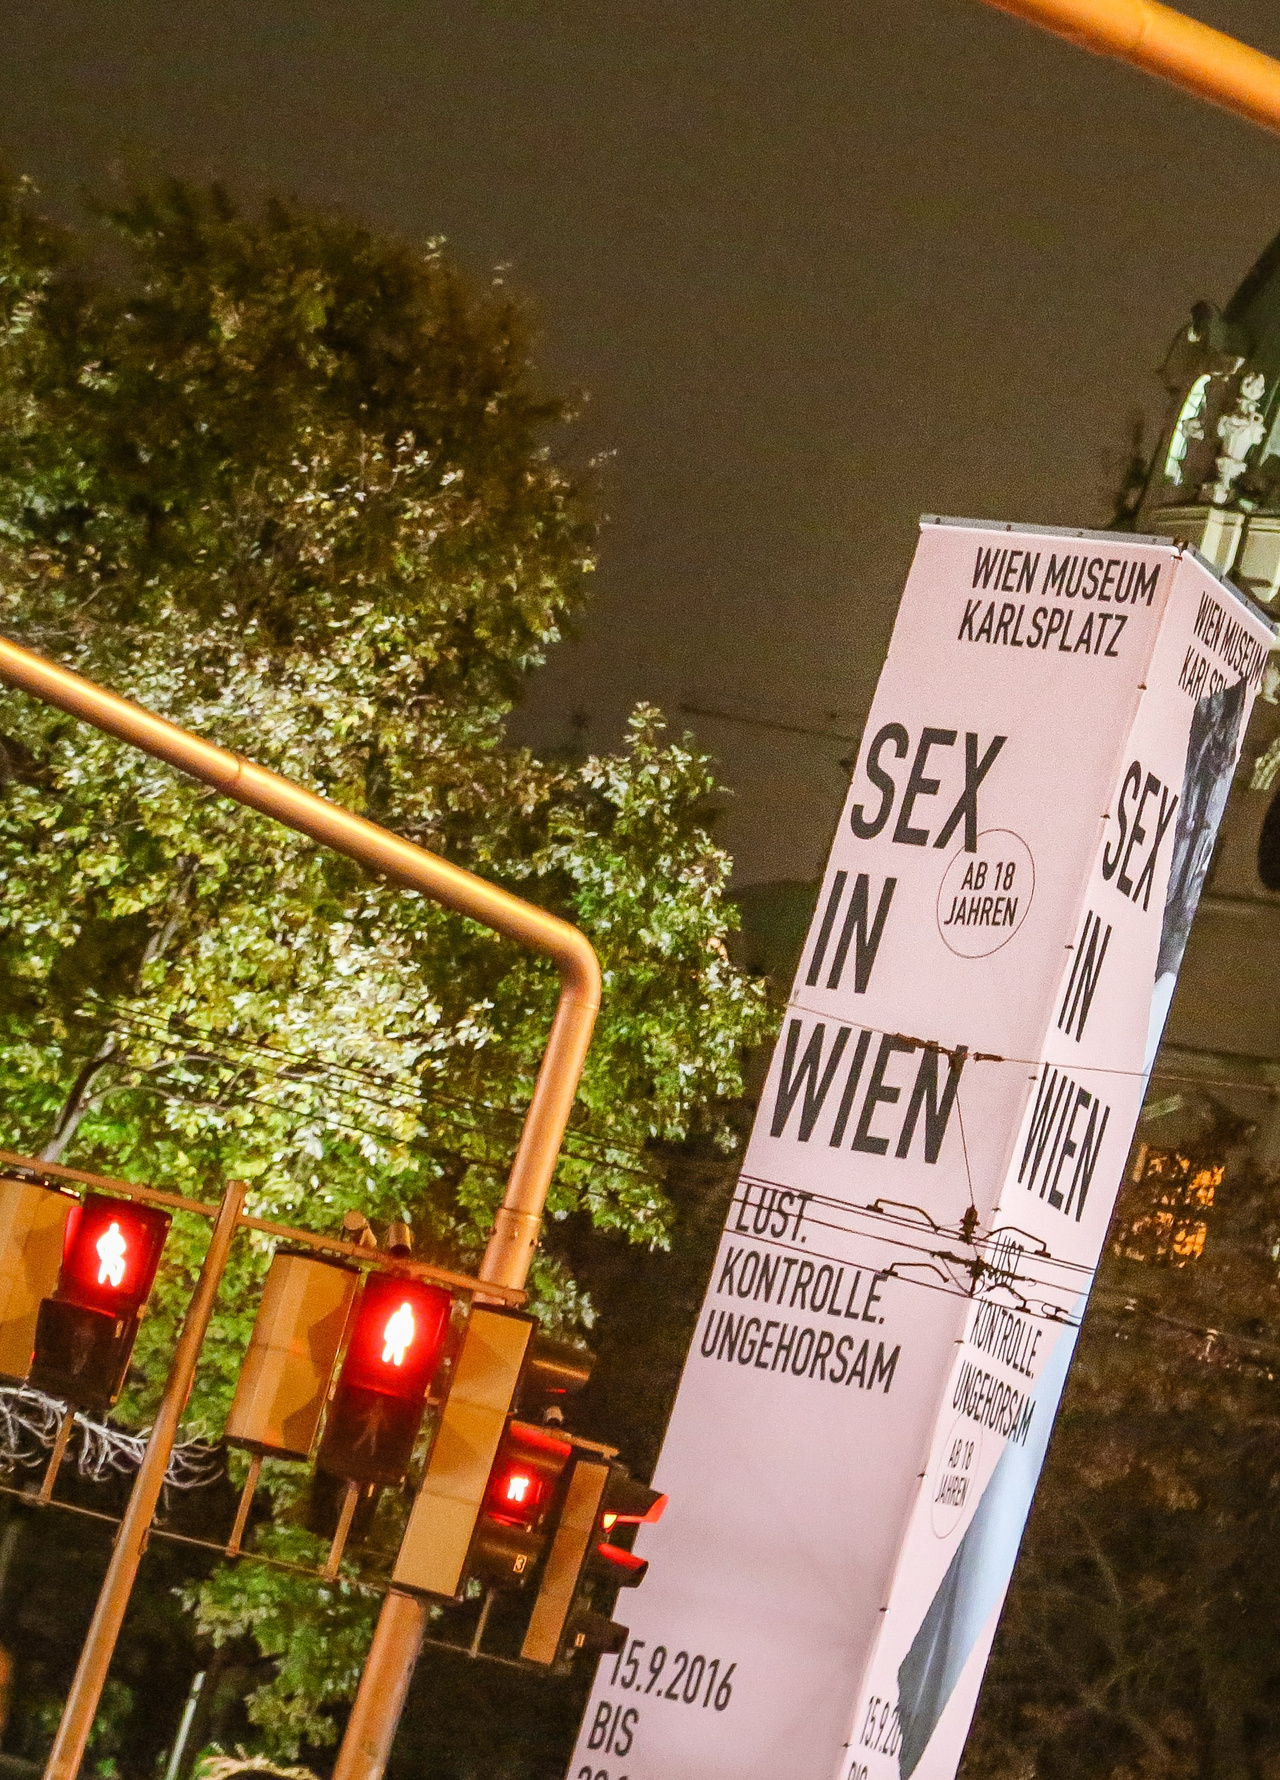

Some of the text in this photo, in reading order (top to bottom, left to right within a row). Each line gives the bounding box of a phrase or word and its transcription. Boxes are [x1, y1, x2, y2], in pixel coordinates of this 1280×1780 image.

[972, 546, 1160, 606] WIEN MUSEUM
[958, 599, 1128, 657] KARLSPLATZ
[1193, 590, 1268, 691] WIEN MUSEUM
[850, 722, 1008, 853] SEX
[961, 862, 1016, 891] AB 18
[1102, 760, 1179, 912] SEX
[805, 870, 898, 994] IN
[943, 896, 1019, 928] JAHREN
[1057, 910, 1113, 1042] IN
[769, 1018, 968, 1165] WIEN
[1017, 1062, 1111, 1222] WIEN
[735, 1184, 811, 1243] LUST.
[716, 1246, 888, 1325] KONTROLLE.
[701, 1309, 901, 1394] UNGEHORSAM
[970, 1296, 1042, 1379] KONTROLLE.
[953, 1360, 1036, 1447] UNGEHORSAM
[935, 1474, 970, 1507] JAHREN
[948, 1438, 975, 1470] AB 18
[610, 1639, 738, 1712] 15.9.2016
[587, 1701, 639, 1757] BIS
